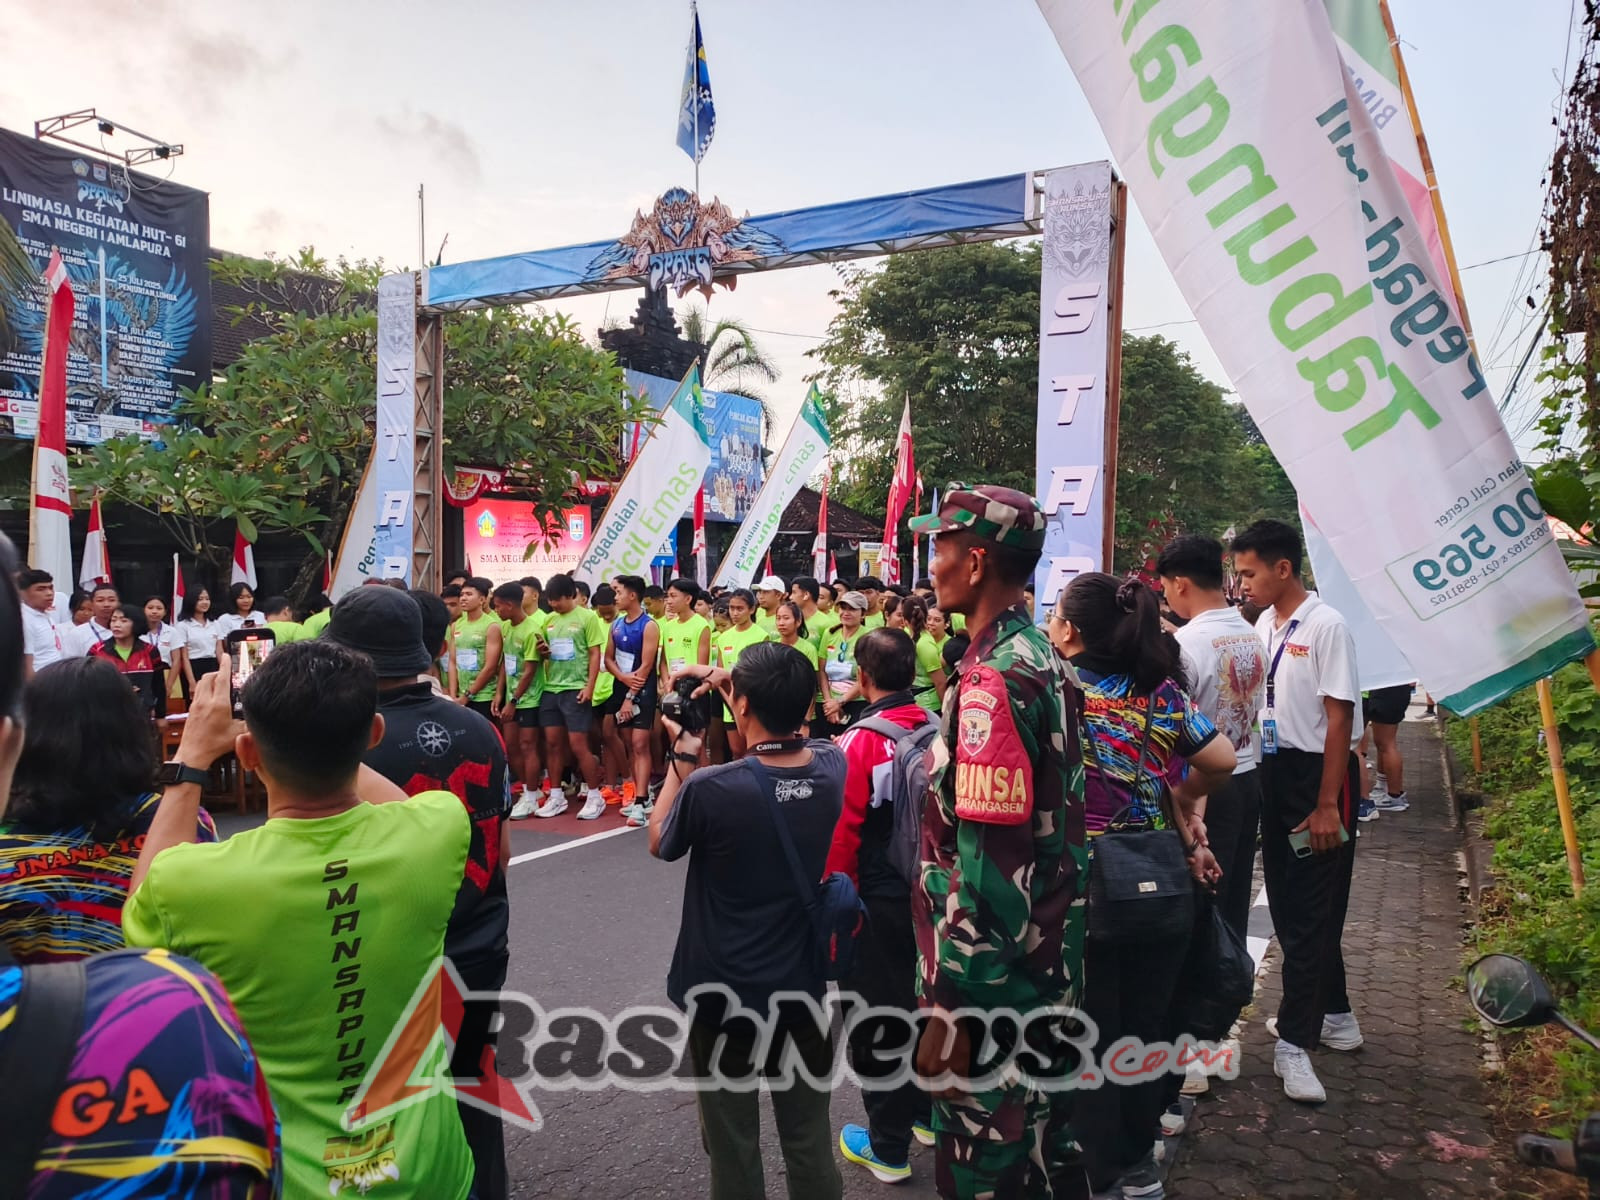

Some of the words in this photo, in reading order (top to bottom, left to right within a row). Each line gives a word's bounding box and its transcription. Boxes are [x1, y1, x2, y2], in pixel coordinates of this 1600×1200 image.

[3, 187, 73, 218] LINIMASA
[76, 207, 139, 235] KEGIATAN
[22, 211, 51, 227] SMA
[54, 219, 98, 239] NEGERI
[107, 233, 172, 258] AMLAPURA
[639, 462, 698, 534] Emas
[582, 498, 638, 574] Pegadaian
[480, 554, 499, 563] SMA
[756, 742, 782, 751] Canon
[956, 763, 1027, 802] BINSA
[13, 844, 110, 878] JNANA
